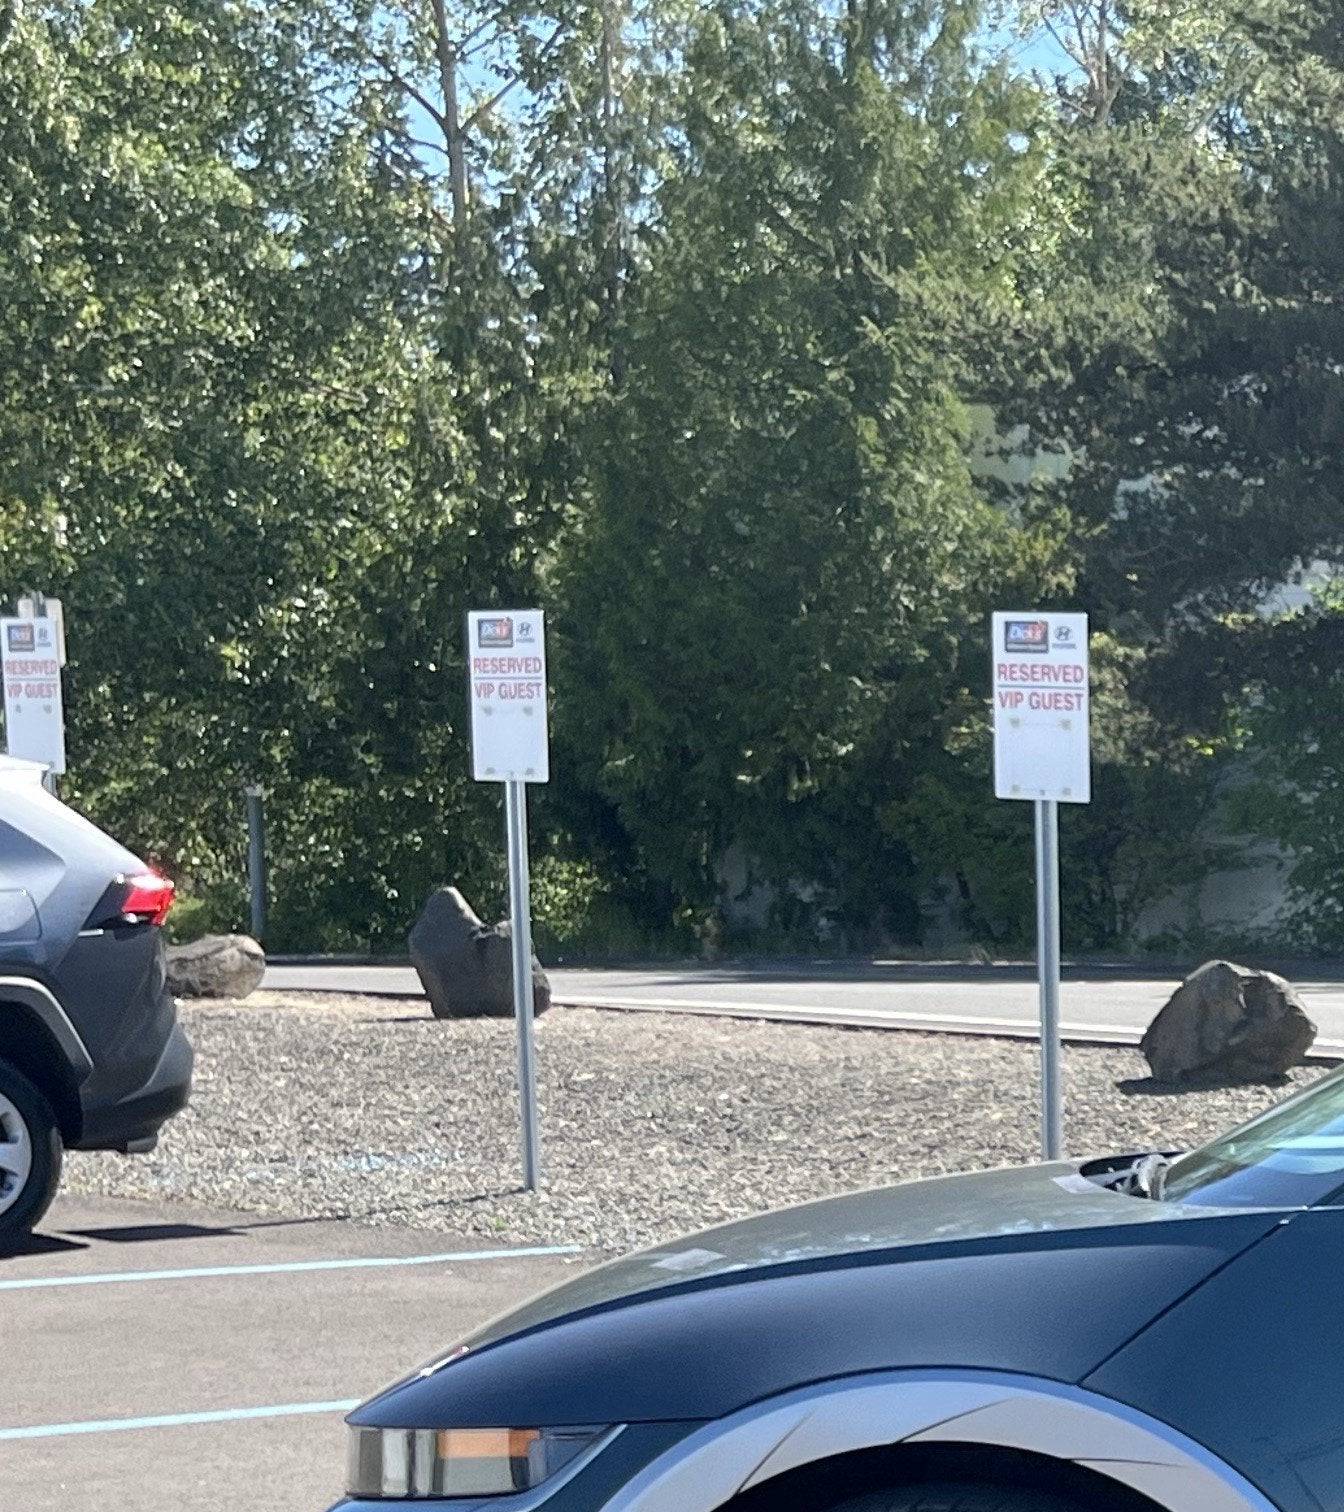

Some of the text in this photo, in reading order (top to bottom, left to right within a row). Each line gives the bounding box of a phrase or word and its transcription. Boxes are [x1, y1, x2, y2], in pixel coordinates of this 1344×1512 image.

[473, 656, 543, 674] RESERVED
[997, 663, 1085, 683] RESERVED
[474, 682, 542, 700] VIP GUEST
[998, 691, 1084, 711] VIP GUEST
